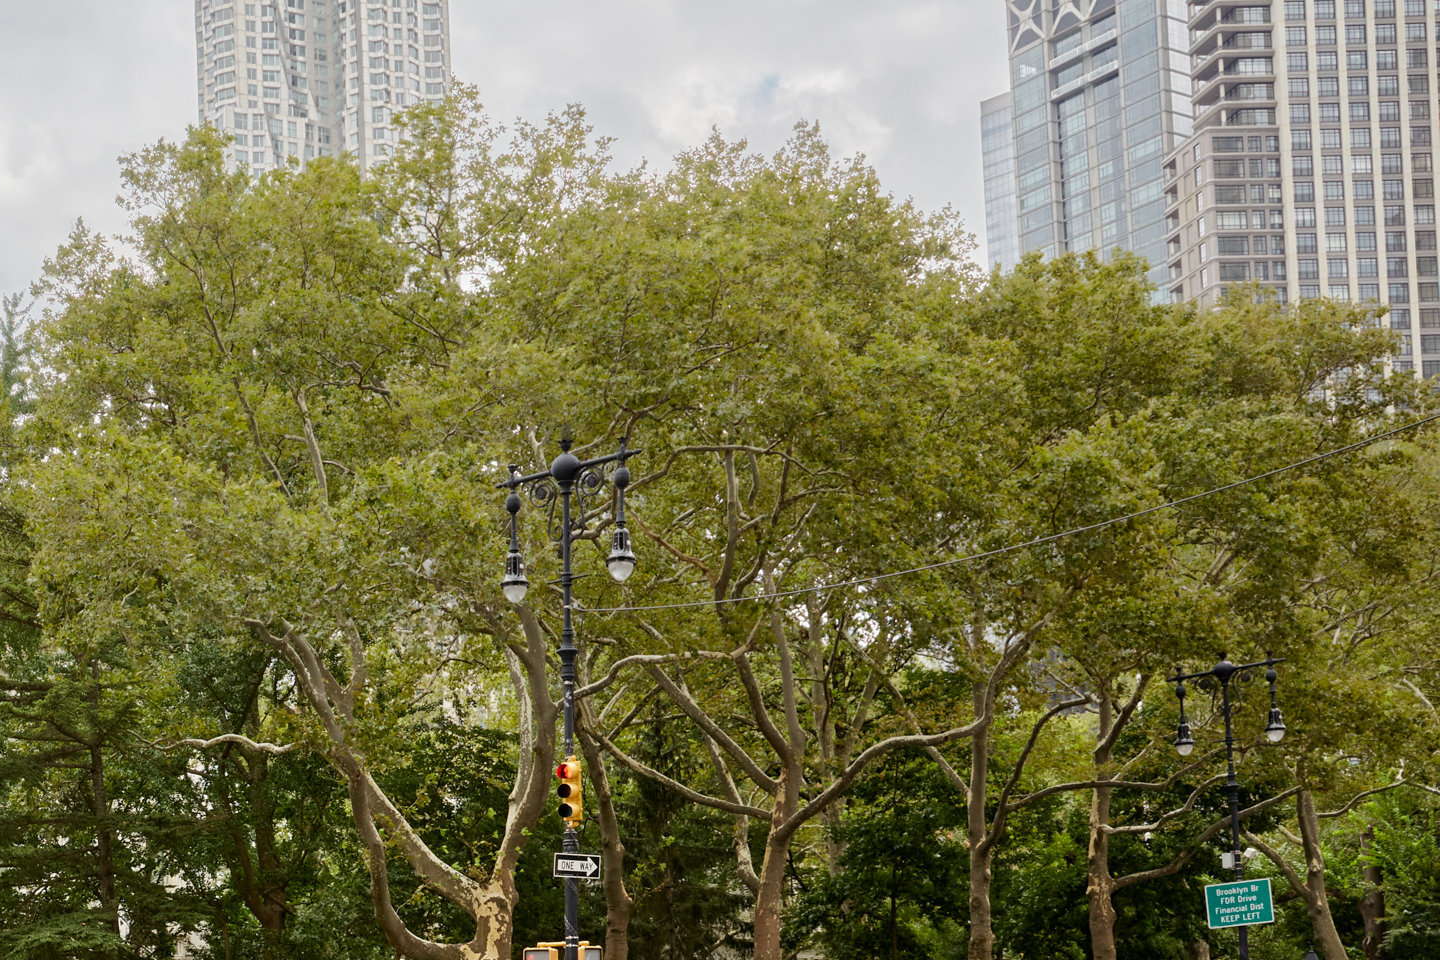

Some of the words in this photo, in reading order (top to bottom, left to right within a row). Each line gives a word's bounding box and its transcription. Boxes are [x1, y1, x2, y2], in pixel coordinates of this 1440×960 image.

[561, 861, 574, 869] ONE
[580, 862, 593, 870] WAY
[1216, 888, 1248, 896] Brooklyn
[1215, 905, 1247, 914] Financial
[1221, 914, 1240, 923] KEEP
[1243, 912, 1260, 920] LEFT
